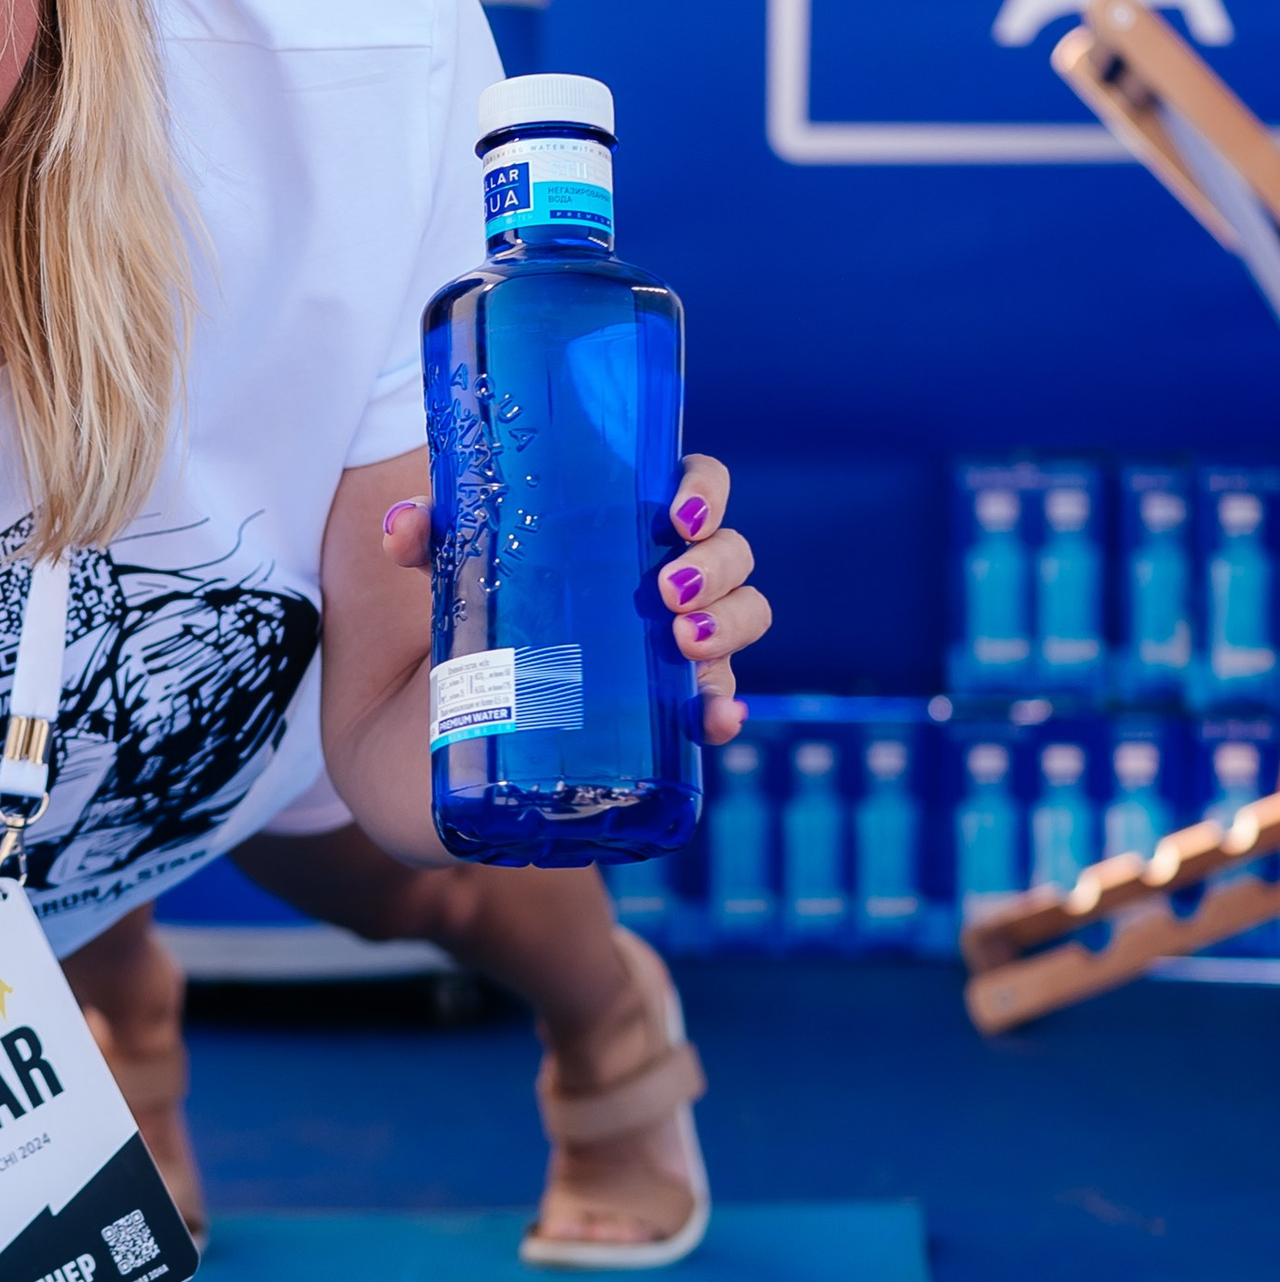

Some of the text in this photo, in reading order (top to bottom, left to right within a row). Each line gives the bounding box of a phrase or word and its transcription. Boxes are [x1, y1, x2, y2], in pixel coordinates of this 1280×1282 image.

[548, 195, 573, 204] ВОДА
[439, 709, 509, 732] PREMIUM WATER
[19, 1132, 52, 1164] 2024
[149, 1264, 169, 1279] ЗОНА
